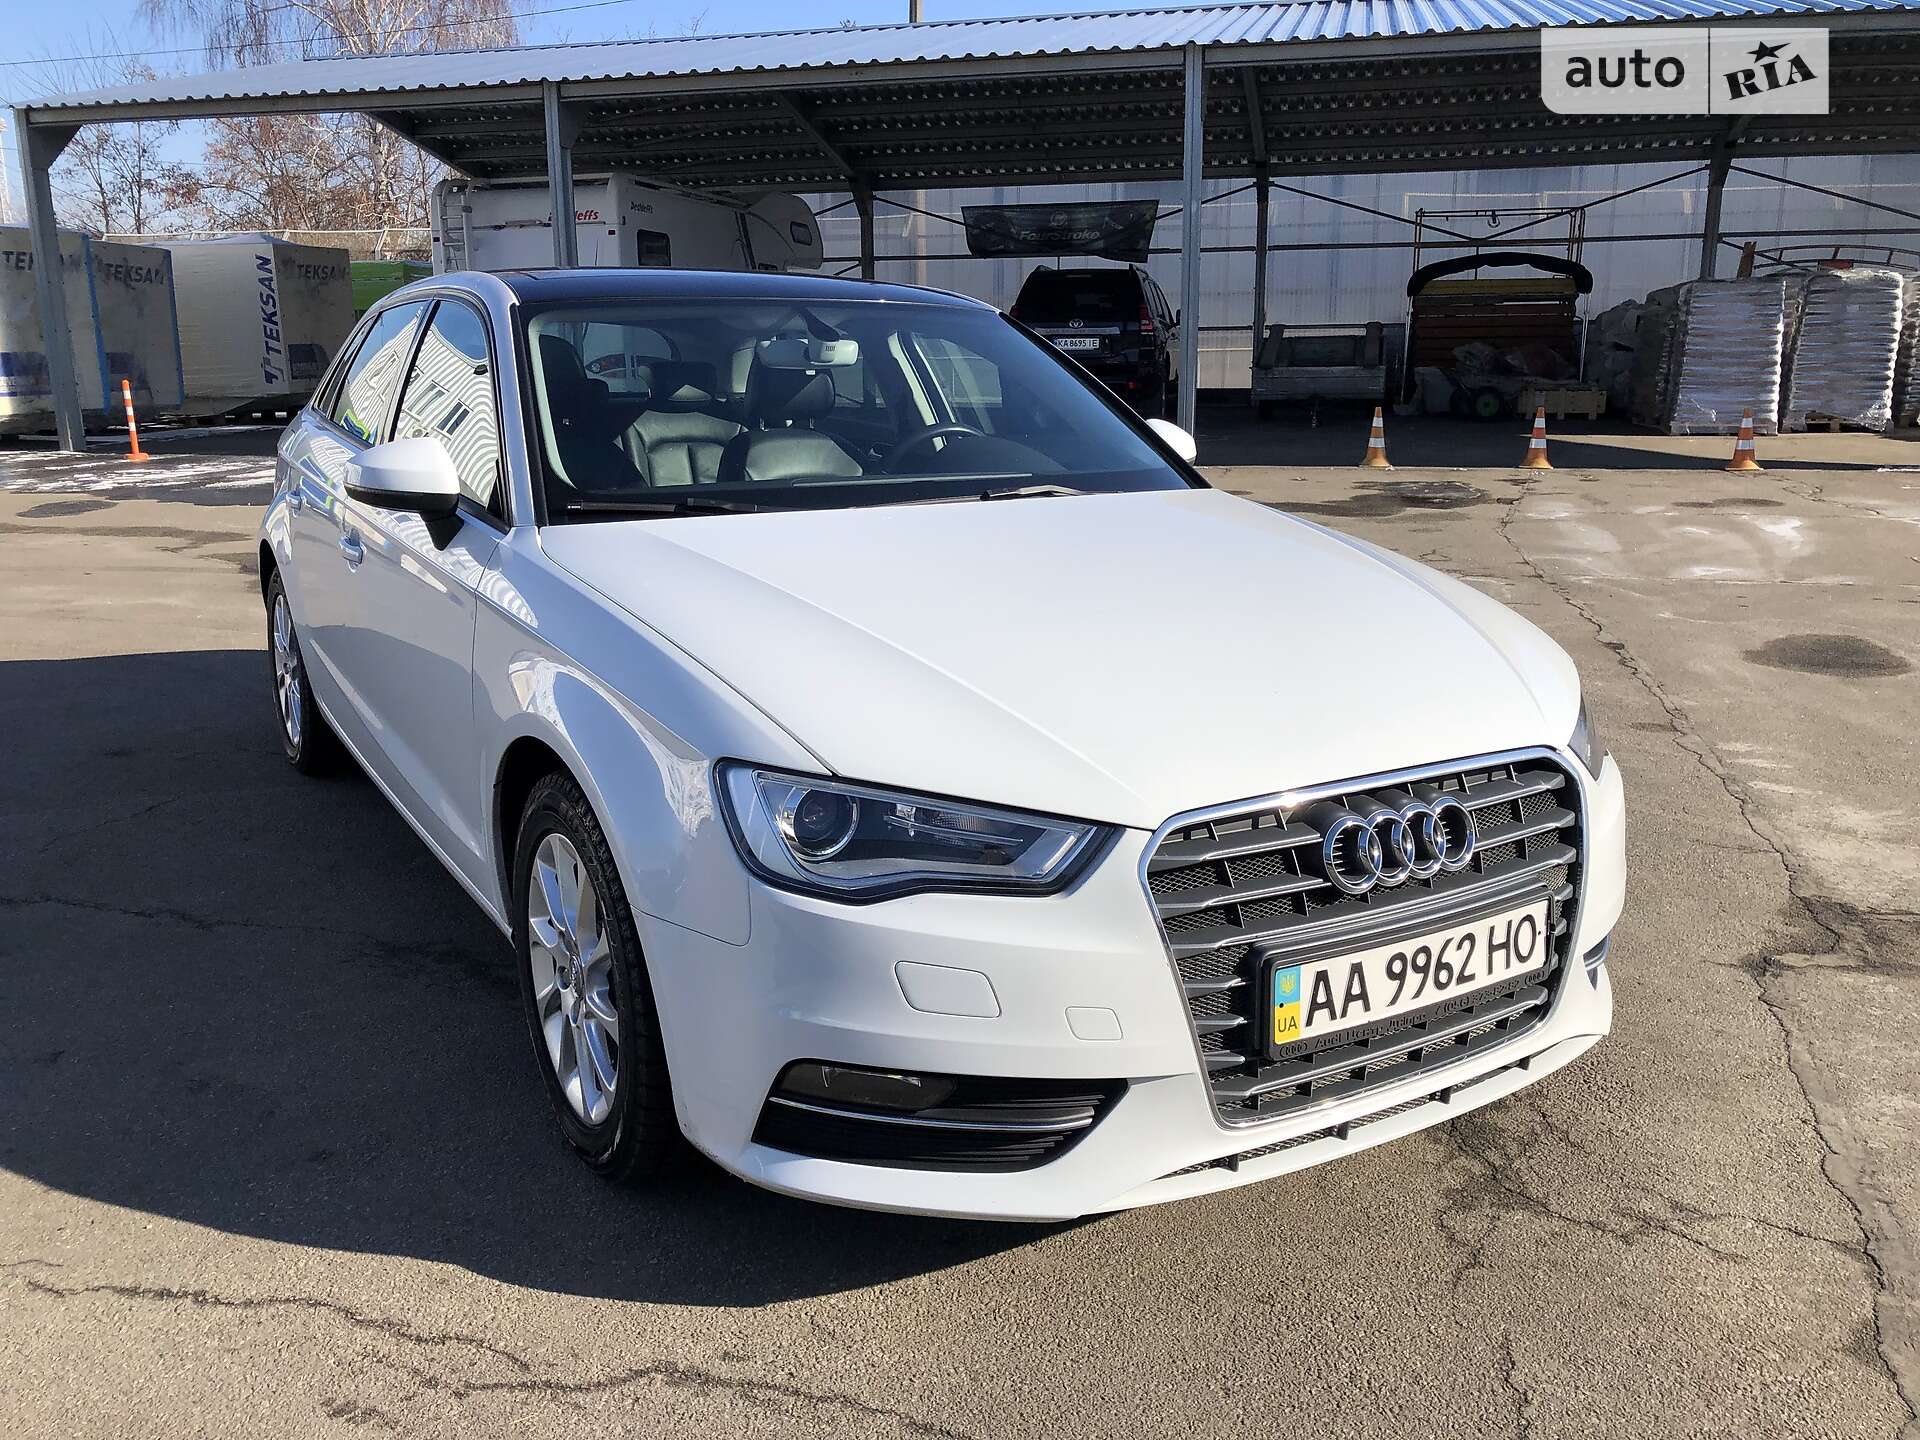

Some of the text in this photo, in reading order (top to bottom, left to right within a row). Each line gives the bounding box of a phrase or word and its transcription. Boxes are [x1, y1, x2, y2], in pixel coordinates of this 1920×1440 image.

[104, 263, 164, 285] TEKSAN
[255, 254, 282, 355] TEKSAN
[1057, 338, 1098, 347] KA 8695 IE
[1305, 914, 1537, 1027] AA 9962 HO
[1277, 1016, 1298, 1033] UA
